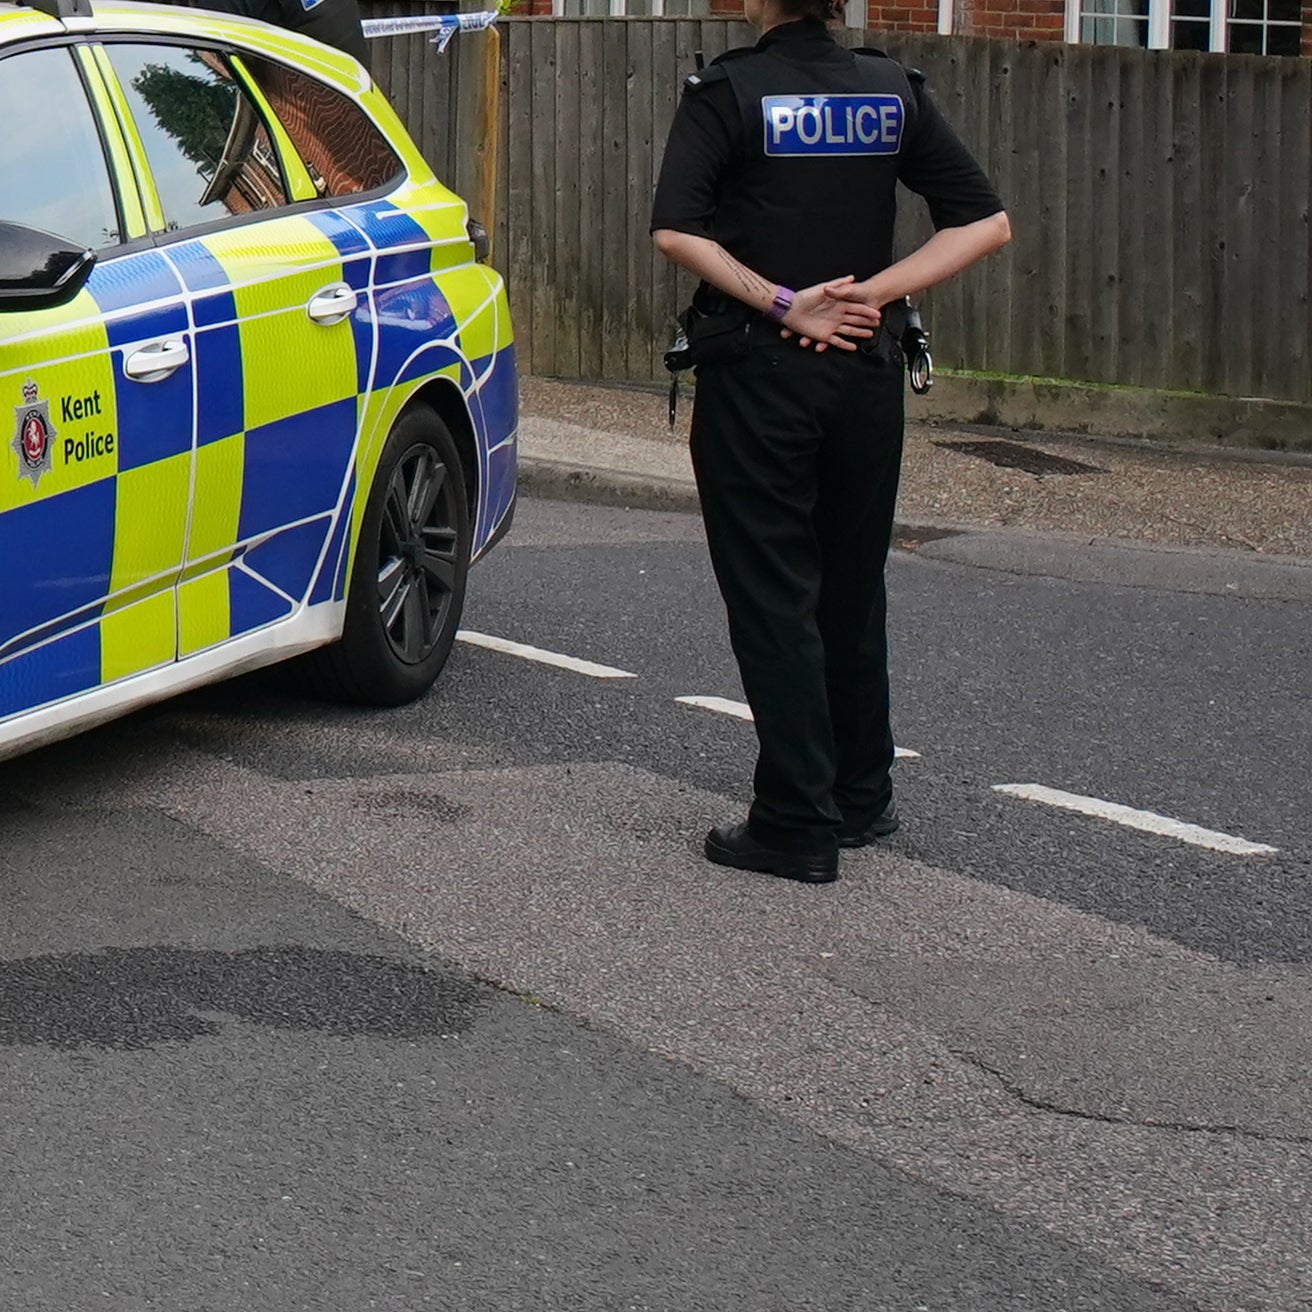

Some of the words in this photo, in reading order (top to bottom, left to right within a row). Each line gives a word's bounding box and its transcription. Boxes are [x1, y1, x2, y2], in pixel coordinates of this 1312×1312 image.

[771, 104, 898, 145] POLICE
[61, 389, 102, 423] Kent
[63, 431, 114, 465] Police
